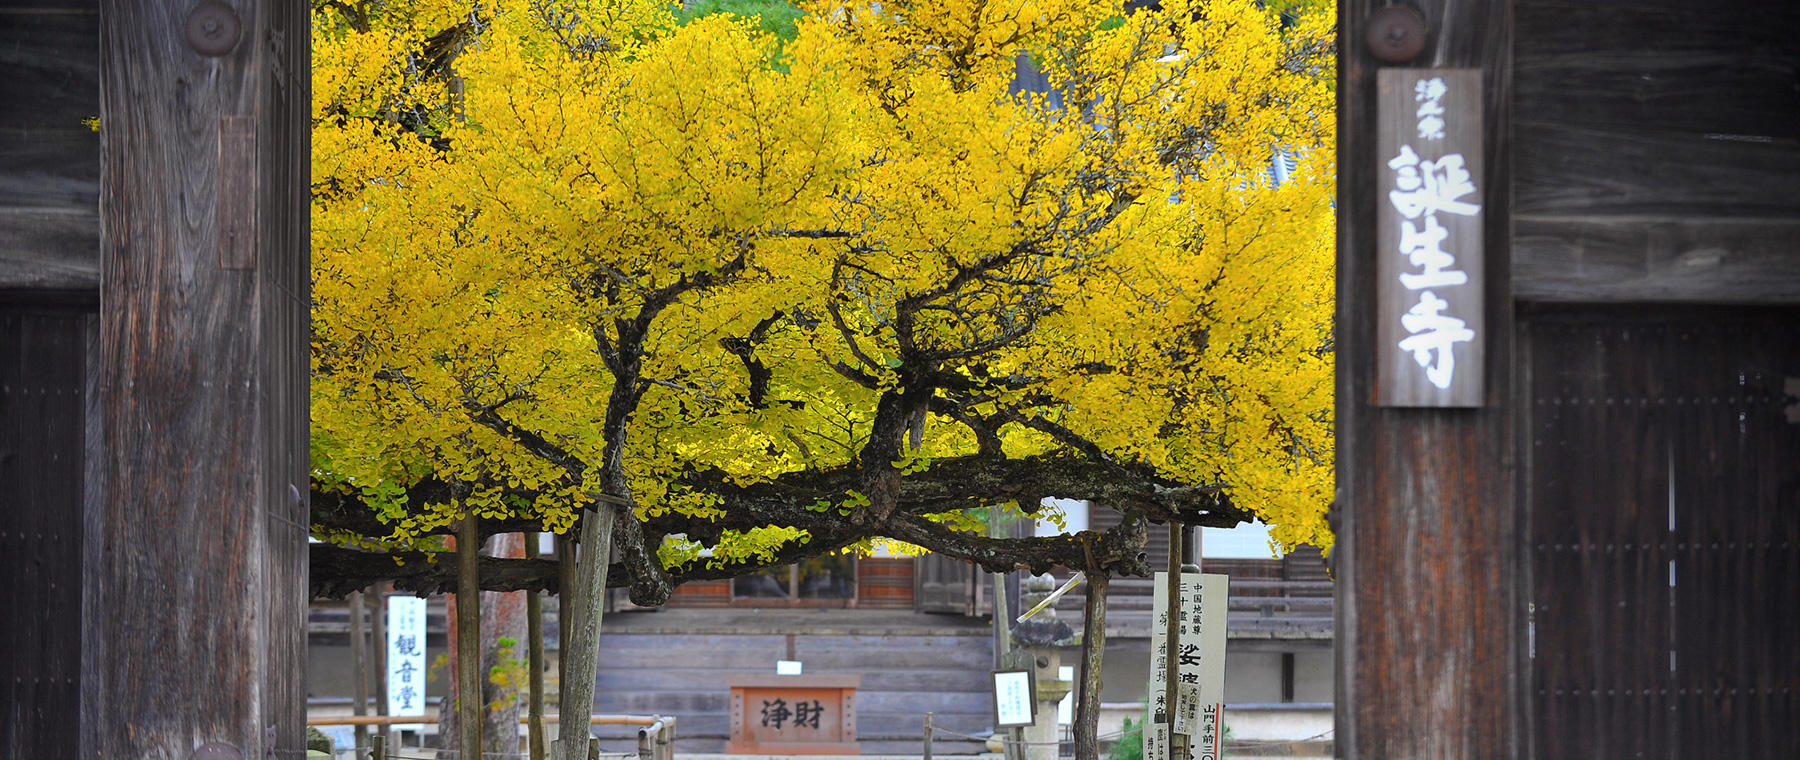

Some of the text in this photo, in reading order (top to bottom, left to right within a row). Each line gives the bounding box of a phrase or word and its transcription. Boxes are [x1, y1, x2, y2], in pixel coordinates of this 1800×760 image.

[1388, 144, 1482, 390] 誕生寺
[394, 633, 421, 710] 観音堂
[761, 698, 825, 730] 浄財
